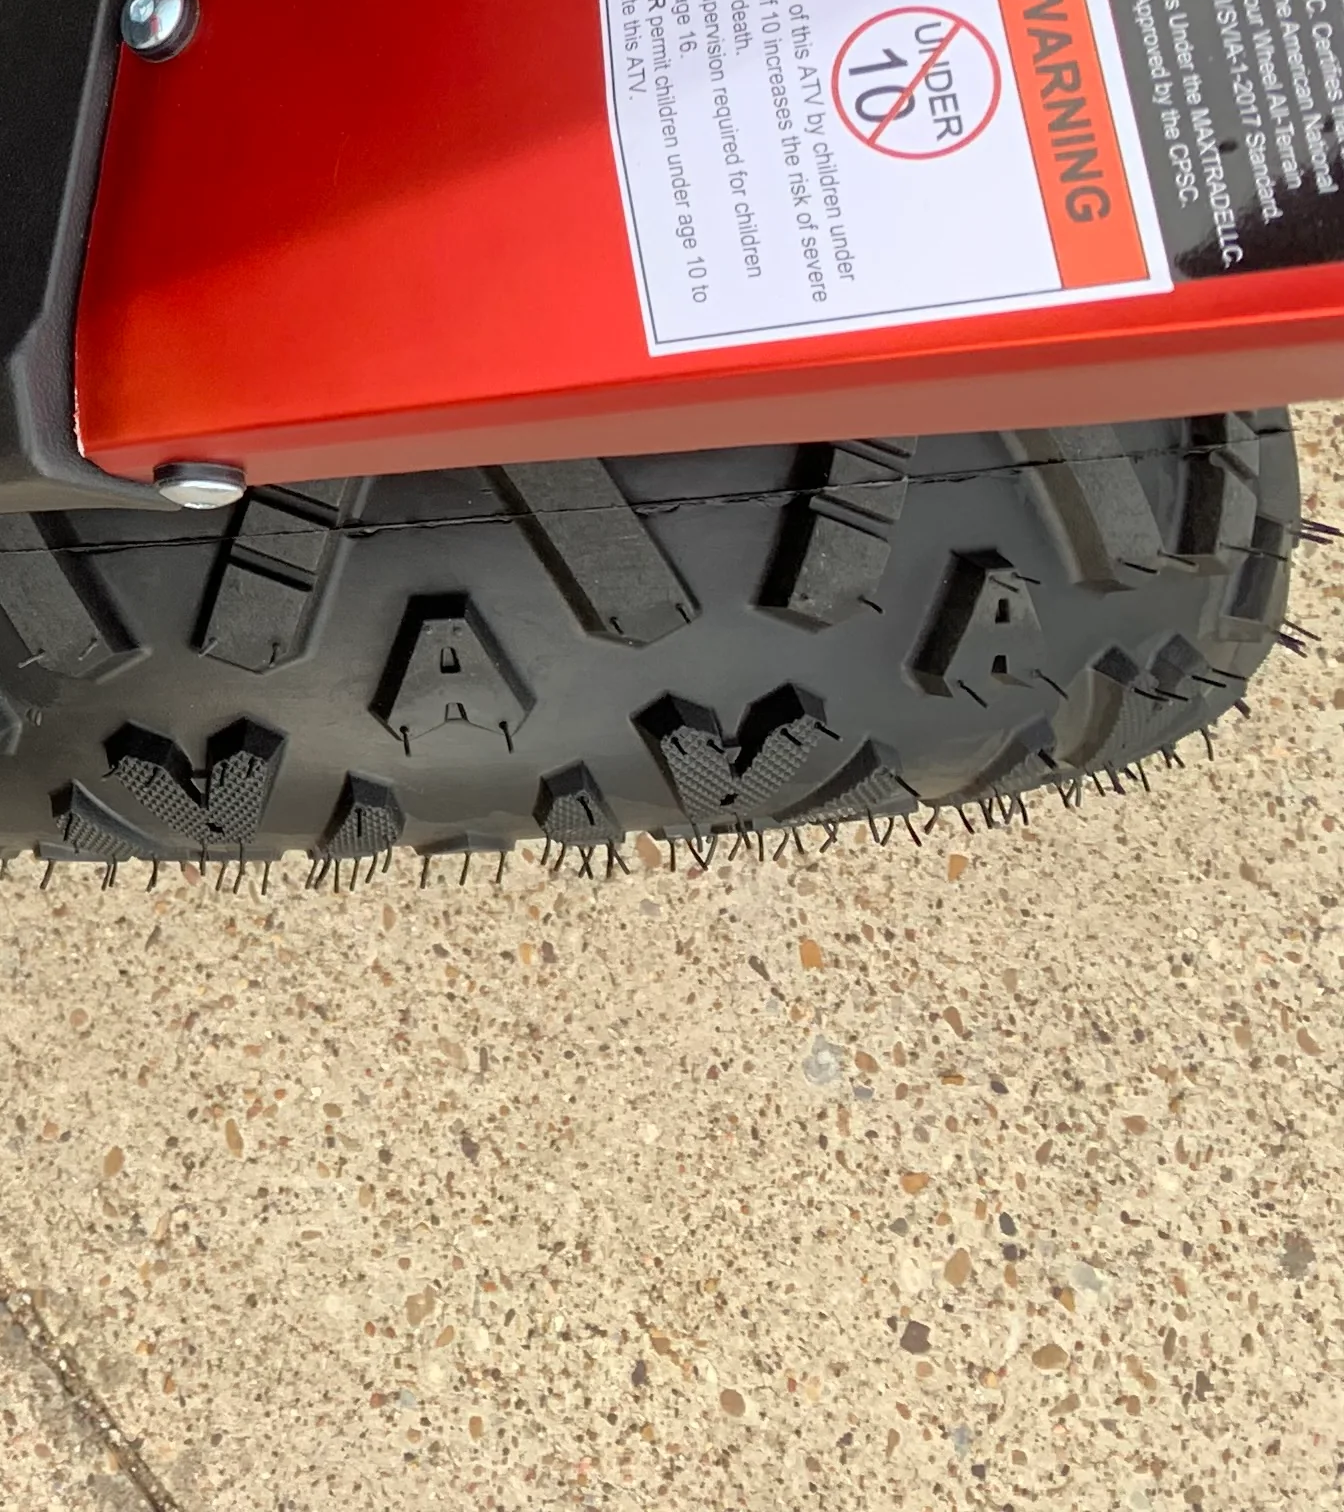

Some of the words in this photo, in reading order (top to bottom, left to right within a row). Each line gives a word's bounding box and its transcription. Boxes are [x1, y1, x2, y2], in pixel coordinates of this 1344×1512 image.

[730, 0, 753, 56] death.
[760, 11, 781, 34] 10
[788, 3, 810, 21] of
[623, 19, 642, 52] this
[645, 15, 672, 72] permit
[679, 31, 698, 59] 16.
[791, 25, 813, 60] this
[626, 56, 647, 101] ATV.
[1168, 12, 1195, 70] Under
[1182, 74, 1202, 105] the
[1252, 29, 1283, 91] Wheel
[763, 37, 793, 131] increases
[797, 65, 825, 106] ATV
[848, 48, 916, 131] 10
[914, 21, 964, 142] UNDER
[1152, 81, 1173, 105] by
[654, 75, 679, 148] children
[712, 87, 745, 166] required
[803, 111, 826, 135] by
[1160, 109, 1181, 140] the
[1280, 21, 1314, 111] American
[1302, 112, 1338, 193] National
[781, 135, 802, 166] the
[1267, 94, 1303, 189] All-Terrain
[666, 153, 691, 208] under
[728, 170, 748, 197] for
[788, 172, 812, 208] risk
[812, 142, 842, 219] children
[675, 214, 697, 250] age
[734, 202, 762, 278] children
[796, 212, 819, 230] of
[686, 256, 708, 279] 10
[800, 236, 828, 302] severe
[829, 224, 855, 281] under
[691, 284, 709, 303] to
